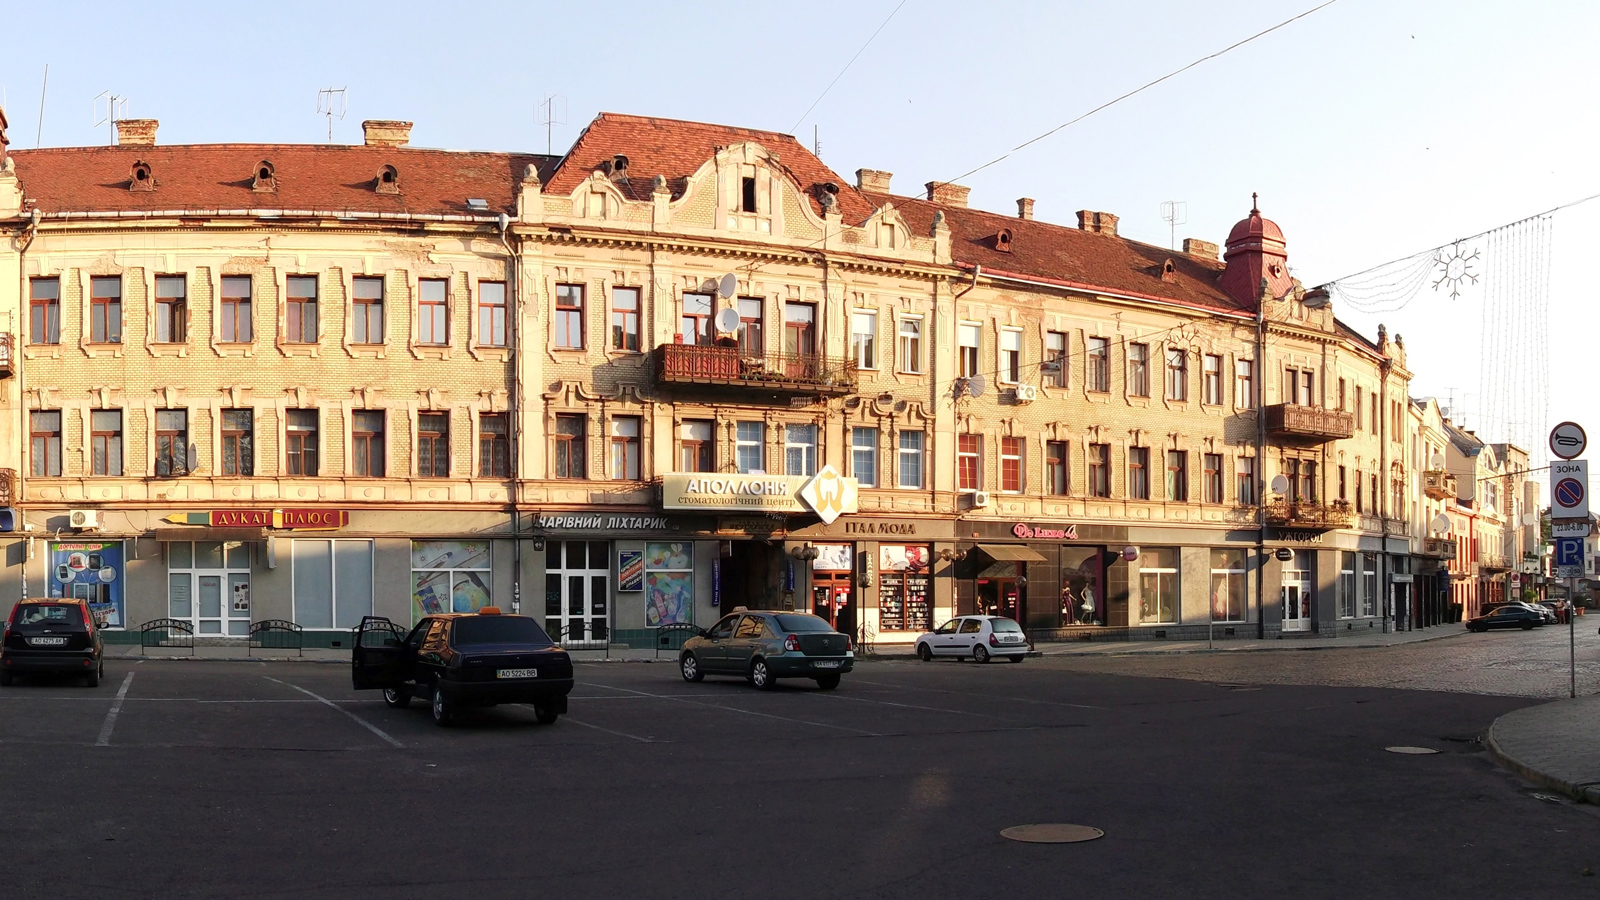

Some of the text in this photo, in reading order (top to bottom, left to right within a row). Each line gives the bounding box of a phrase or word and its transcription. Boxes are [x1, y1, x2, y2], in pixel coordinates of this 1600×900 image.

[1556, 465, 1581, 473] ЗОНА
[686, 480, 788, 496] АПОЛЛОНІЯ
[678, 496, 796, 508] стоматологічний центр
[218, 512, 333, 525] ДУКАТ ПЛЮС
[539, 514, 669, 529] ЧАРІВНИЙ ЛІХТАРИК
[1034, 527, 1065, 539] Luxe
[1278, 531, 1323, 543] УЖГОРОД
[1562, 541, 1578, 563] P
